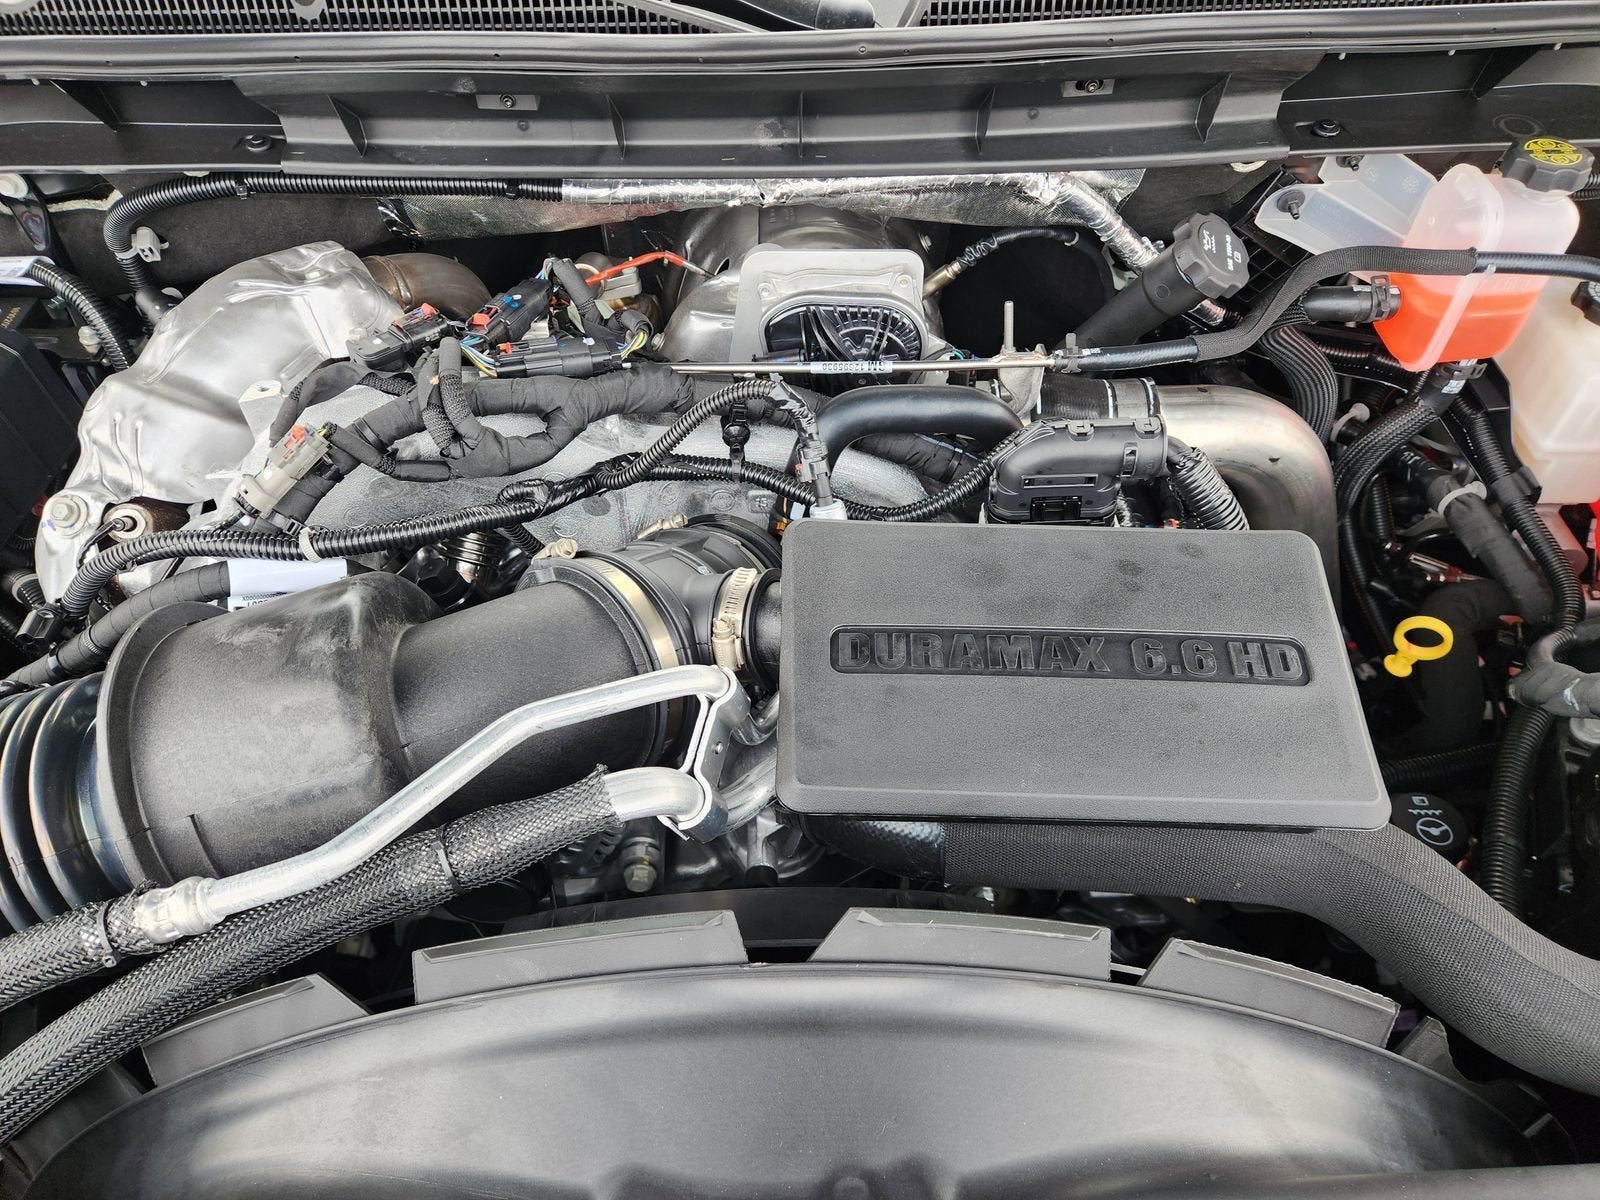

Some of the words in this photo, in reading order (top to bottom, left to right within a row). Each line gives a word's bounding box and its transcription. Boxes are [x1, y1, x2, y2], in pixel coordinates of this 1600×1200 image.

[868, 361, 886, 372] GM
[838, 632, 1111, 672] DURAMAX
[1131, 638, 1219, 677] 6.6
[1227, 641, 1303, 681] HD
